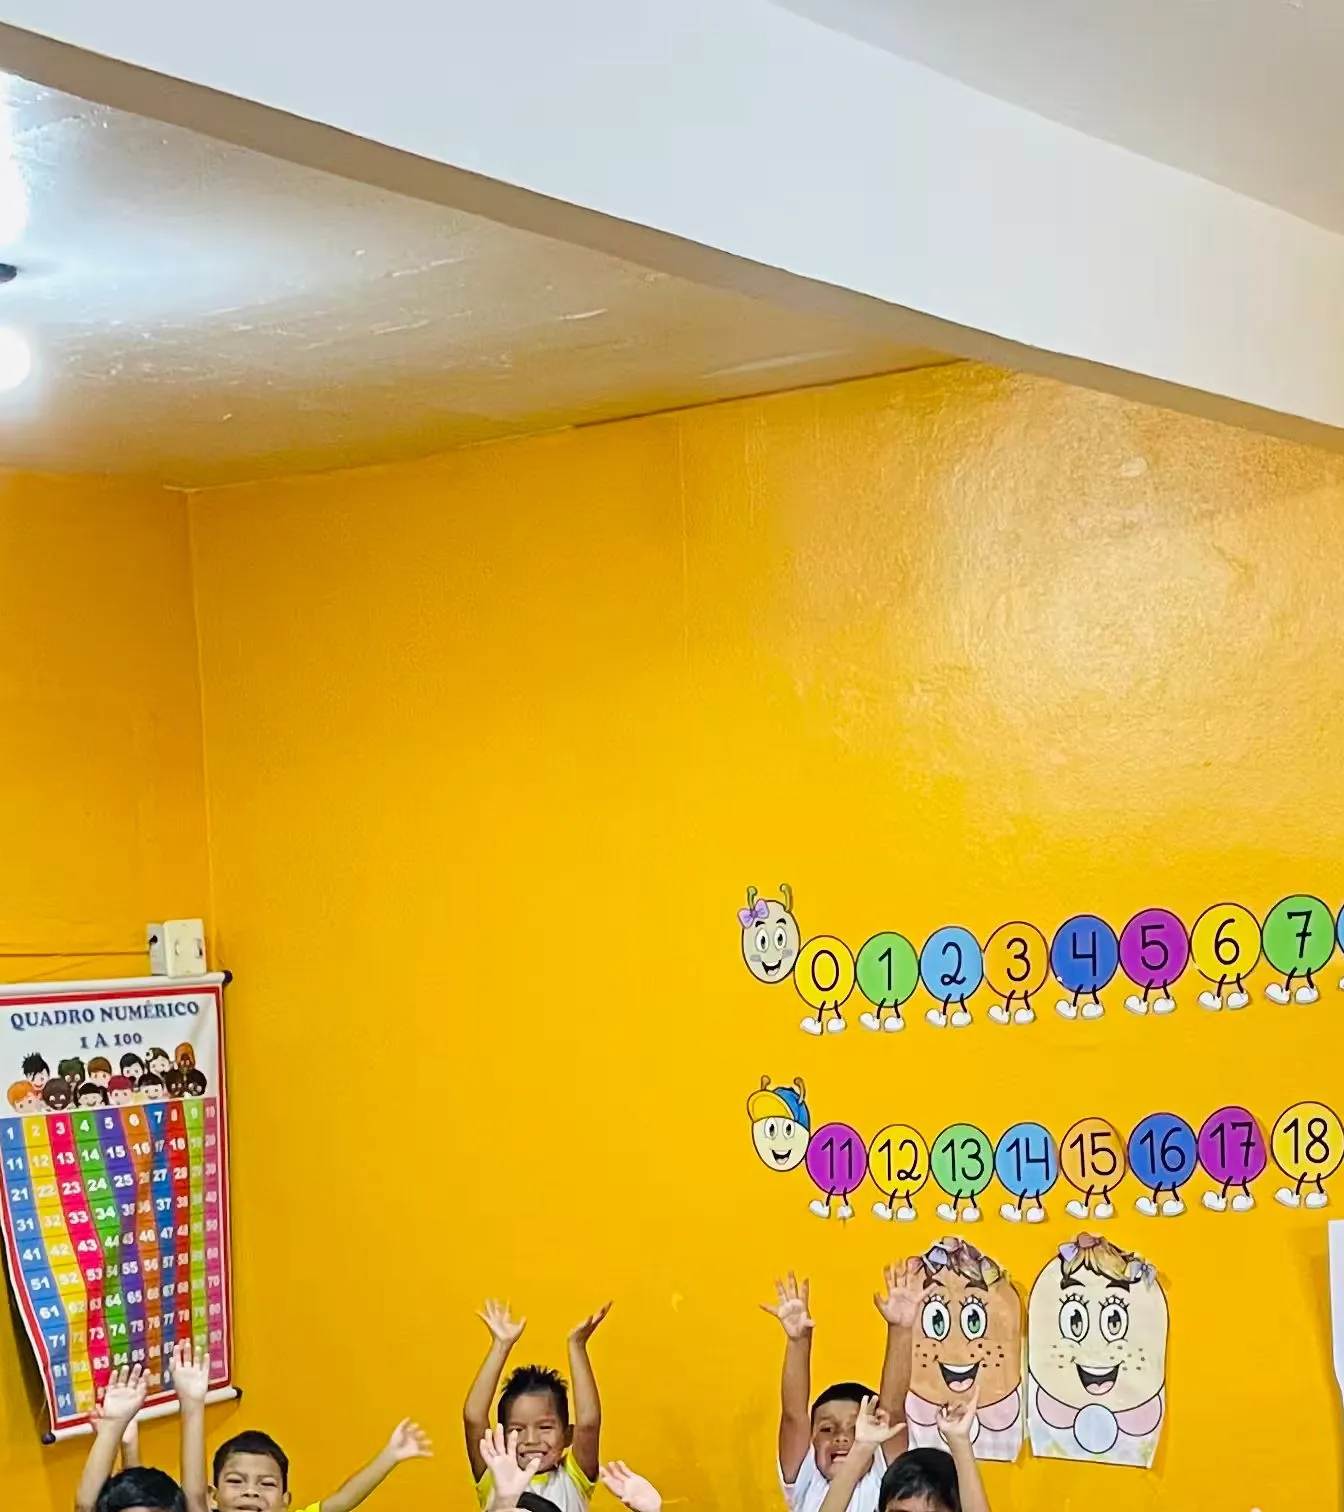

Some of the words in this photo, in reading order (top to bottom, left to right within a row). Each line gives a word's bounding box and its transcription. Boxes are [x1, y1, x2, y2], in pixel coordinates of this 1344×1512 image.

[811, 949, 839, 992] 0
[878, 948, 892, 991] 1
[941, 941, 966, 986] 2
[1007, 937, 1031, 982] 3
[1072, 931, 1097, 977] 4
[1140, 924, 1168, 970] 5
[1214, 918, 1240, 965] 6
[1287, 910, 1312, 958] 7
[11, 1008, 95, 1031] QUADRO
[100, 1000, 200, 1023] NUMÉRICO
[95, 1033, 109, 1048] A
[114, 1032, 142, 1045] 100
[7, 1128, 14, 1139] 1
[32, 1125, 40, 1136] 2
[57, 1122, 65, 1135] 3
[80, 1120, 89, 1132] 4
[105, 1117, 114, 1129] 5
[129, 1114, 139, 1127] 6
[154, 1111, 163, 1123] 7
[7, 1157, 24, 1170] 11
[32, 1154, 48, 1167] 12
[57, 1152, 75, 1165] 13
[82, 1149, 100, 1161] 14
[107, 1147, 126, 1159] 15
[133, 1142, 150, 1155] 16
[821, 1137, 853, 1180] 11
[878, 1139, 921, 1181] 12
[942, 1138, 984, 1181] 13
[1006, 1137, 1050, 1181] 14
[1070, 1132, 1117, 1177] 15
[1140, 1127, 1186, 1174] 16
[1209, 1121, 1256, 1168] 17
[1283, 1117, 1330, 1164] 18
[11, 1188, 28, 1200] 21
[63, 1182, 81, 1195] 23
[88, 1178, 106, 1191] 24
[114, 1174, 133, 1187] 25
[153, 1169, 167, 1181] 27
[16, 1217, 34, 1232] 31
[69, 1211, 88, 1224] 33
[96, 1207, 115, 1219] 34
[157, 1198, 171, 1210] 37
[23, 1248, 41, 1261] 41
[78, 1239, 98, 1252] 43
[105, 1235, 119, 1247] 44
[161, 1227, 173, 1239] 47
[31, 1276, 50, 1290] 51
[86, 1268, 102, 1281] 53
[123, 1262, 138, 1274] 55
[163, 1256, 173, 1268] 57
[40, 1305, 59, 1319] 61
[106, 1294, 121, 1307] 64
[127, 1291, 142, 1304] 65
[208, 1276, 219, 1287] 70
[49, 1334, 66, 1348] 71
[89, 1328, 104, 1340] 73
[111, 1324, 126, 1336] 74
[164, 1313, 174, 1325] 77
